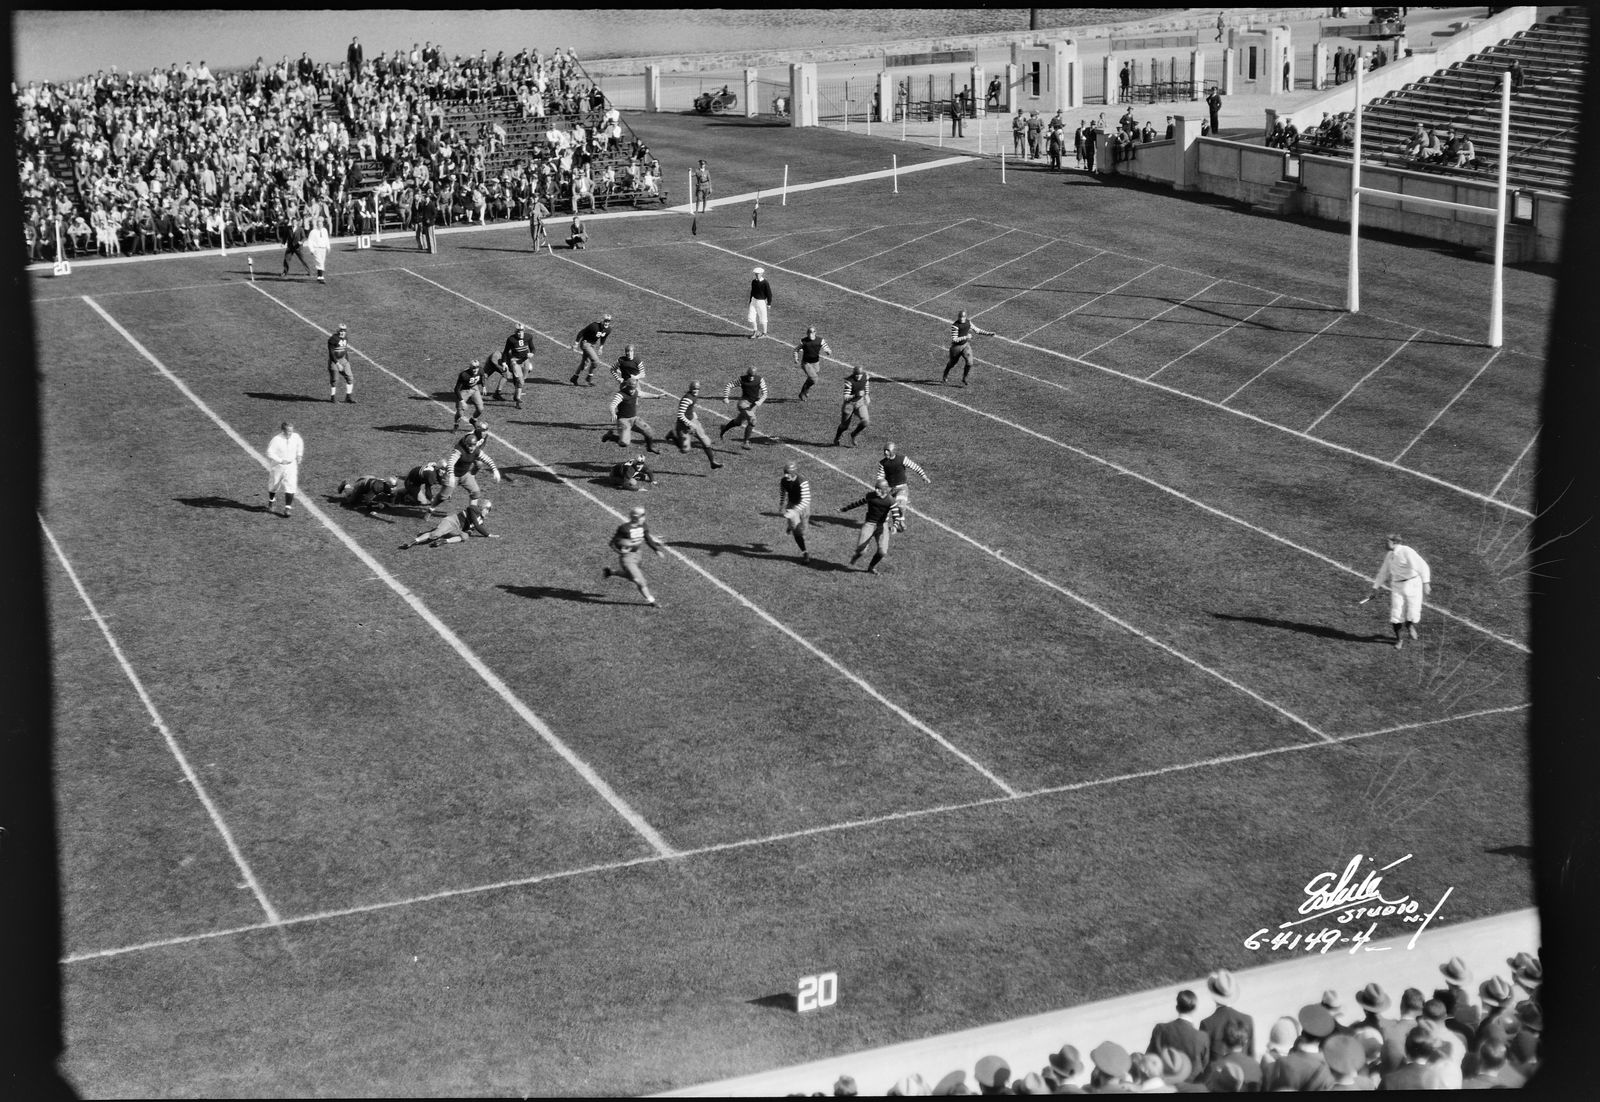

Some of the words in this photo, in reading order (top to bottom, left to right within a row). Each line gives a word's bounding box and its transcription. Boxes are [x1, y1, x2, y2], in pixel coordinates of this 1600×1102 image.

[357, 235, 371, 249] 10
[53, 260, 72, 276] 20
[797, 971, 838, 1012] 20
